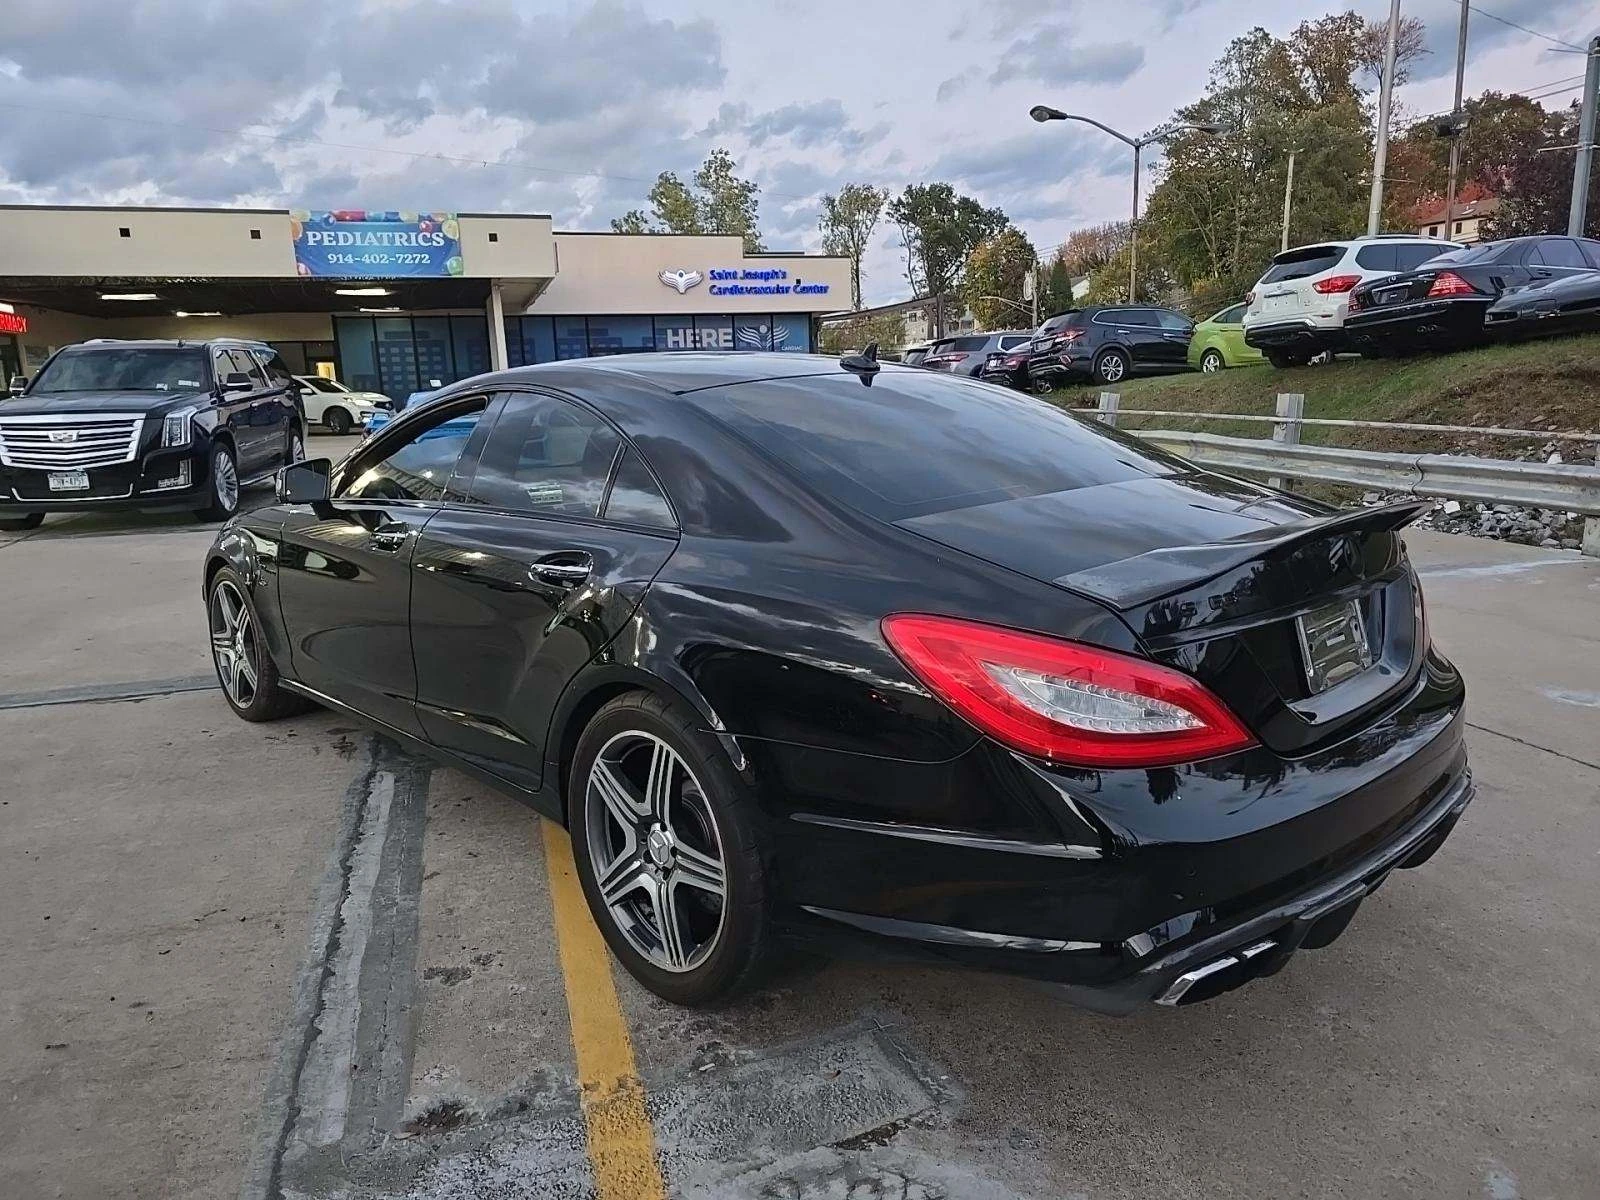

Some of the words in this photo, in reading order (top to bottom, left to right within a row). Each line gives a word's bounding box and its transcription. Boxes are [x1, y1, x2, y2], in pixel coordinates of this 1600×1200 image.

[306, 231, 445, 247] PEDIATRICS
[327, 253, 431, 265] 914-402-7272
[709, 269, 738, 280] Saint
[709, 284, 791, 295] Cardiovascular
[792, 284, 830, 295] Center
[667, 328, 734, 349] HERE
